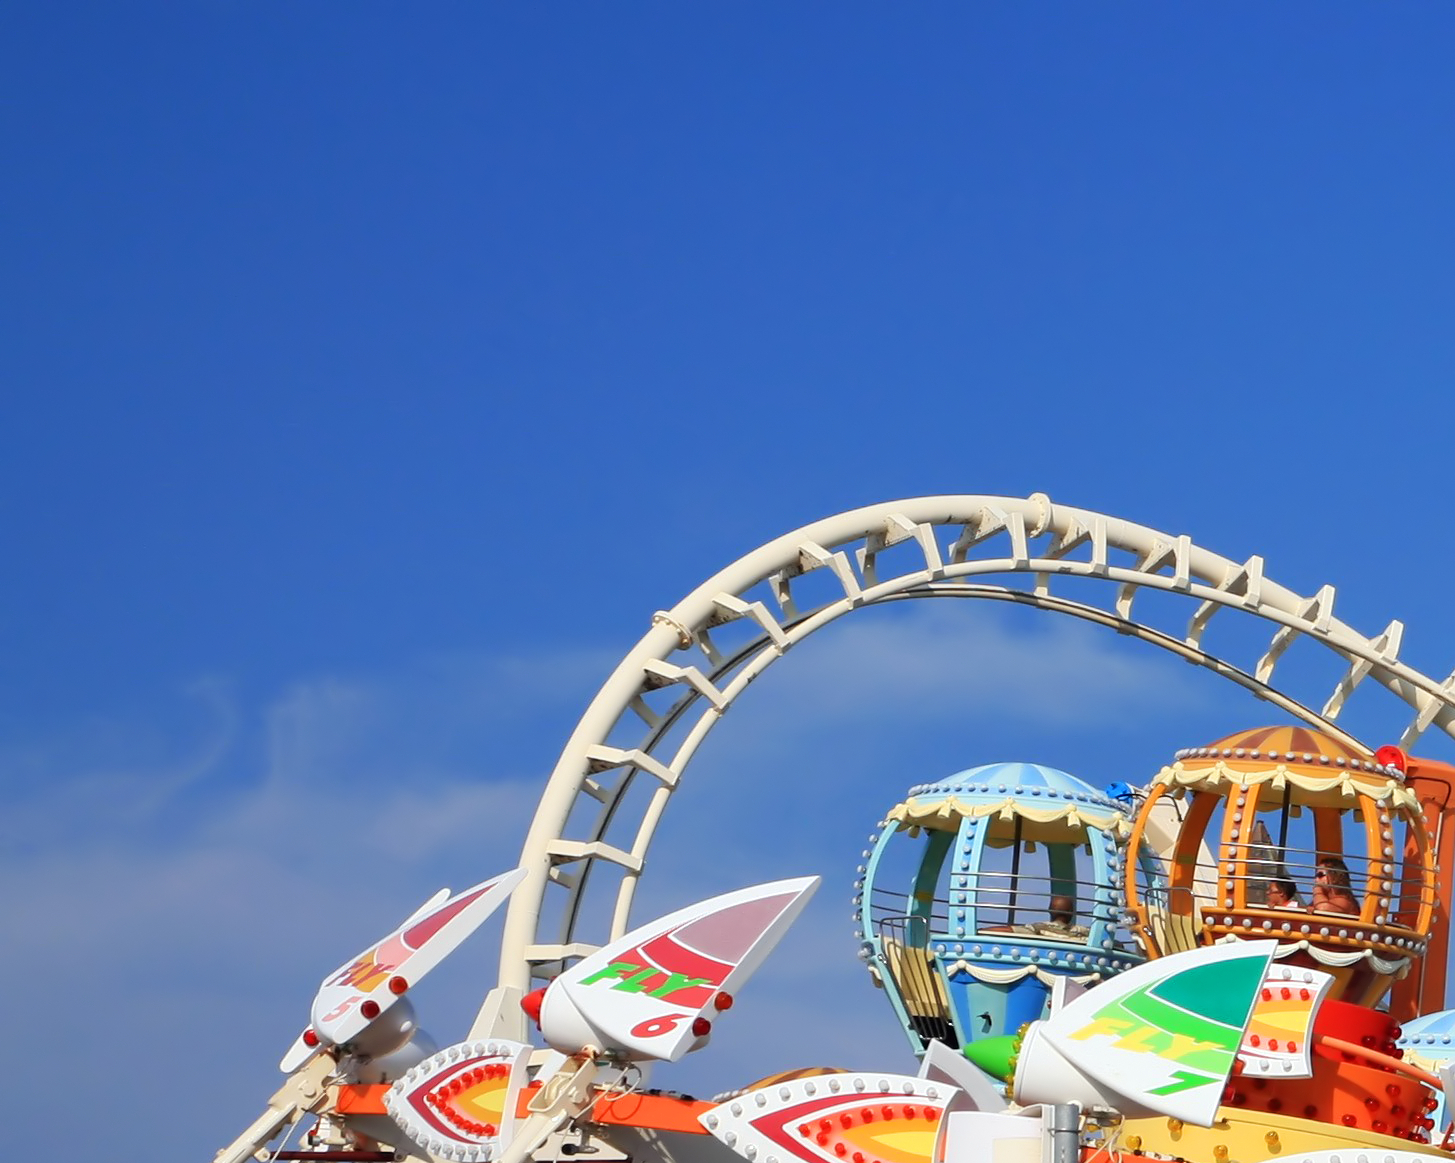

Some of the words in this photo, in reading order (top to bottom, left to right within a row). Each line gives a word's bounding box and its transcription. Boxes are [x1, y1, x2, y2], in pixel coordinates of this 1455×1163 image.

[576, 962, 713, 998] FLY
[321, 996, 362, 1022] 5
[630, 1013, 694, 1038] 6
[1066, 1017, 1226, 1060] FLY
[1143, 1070, 1223, 1096] 7
